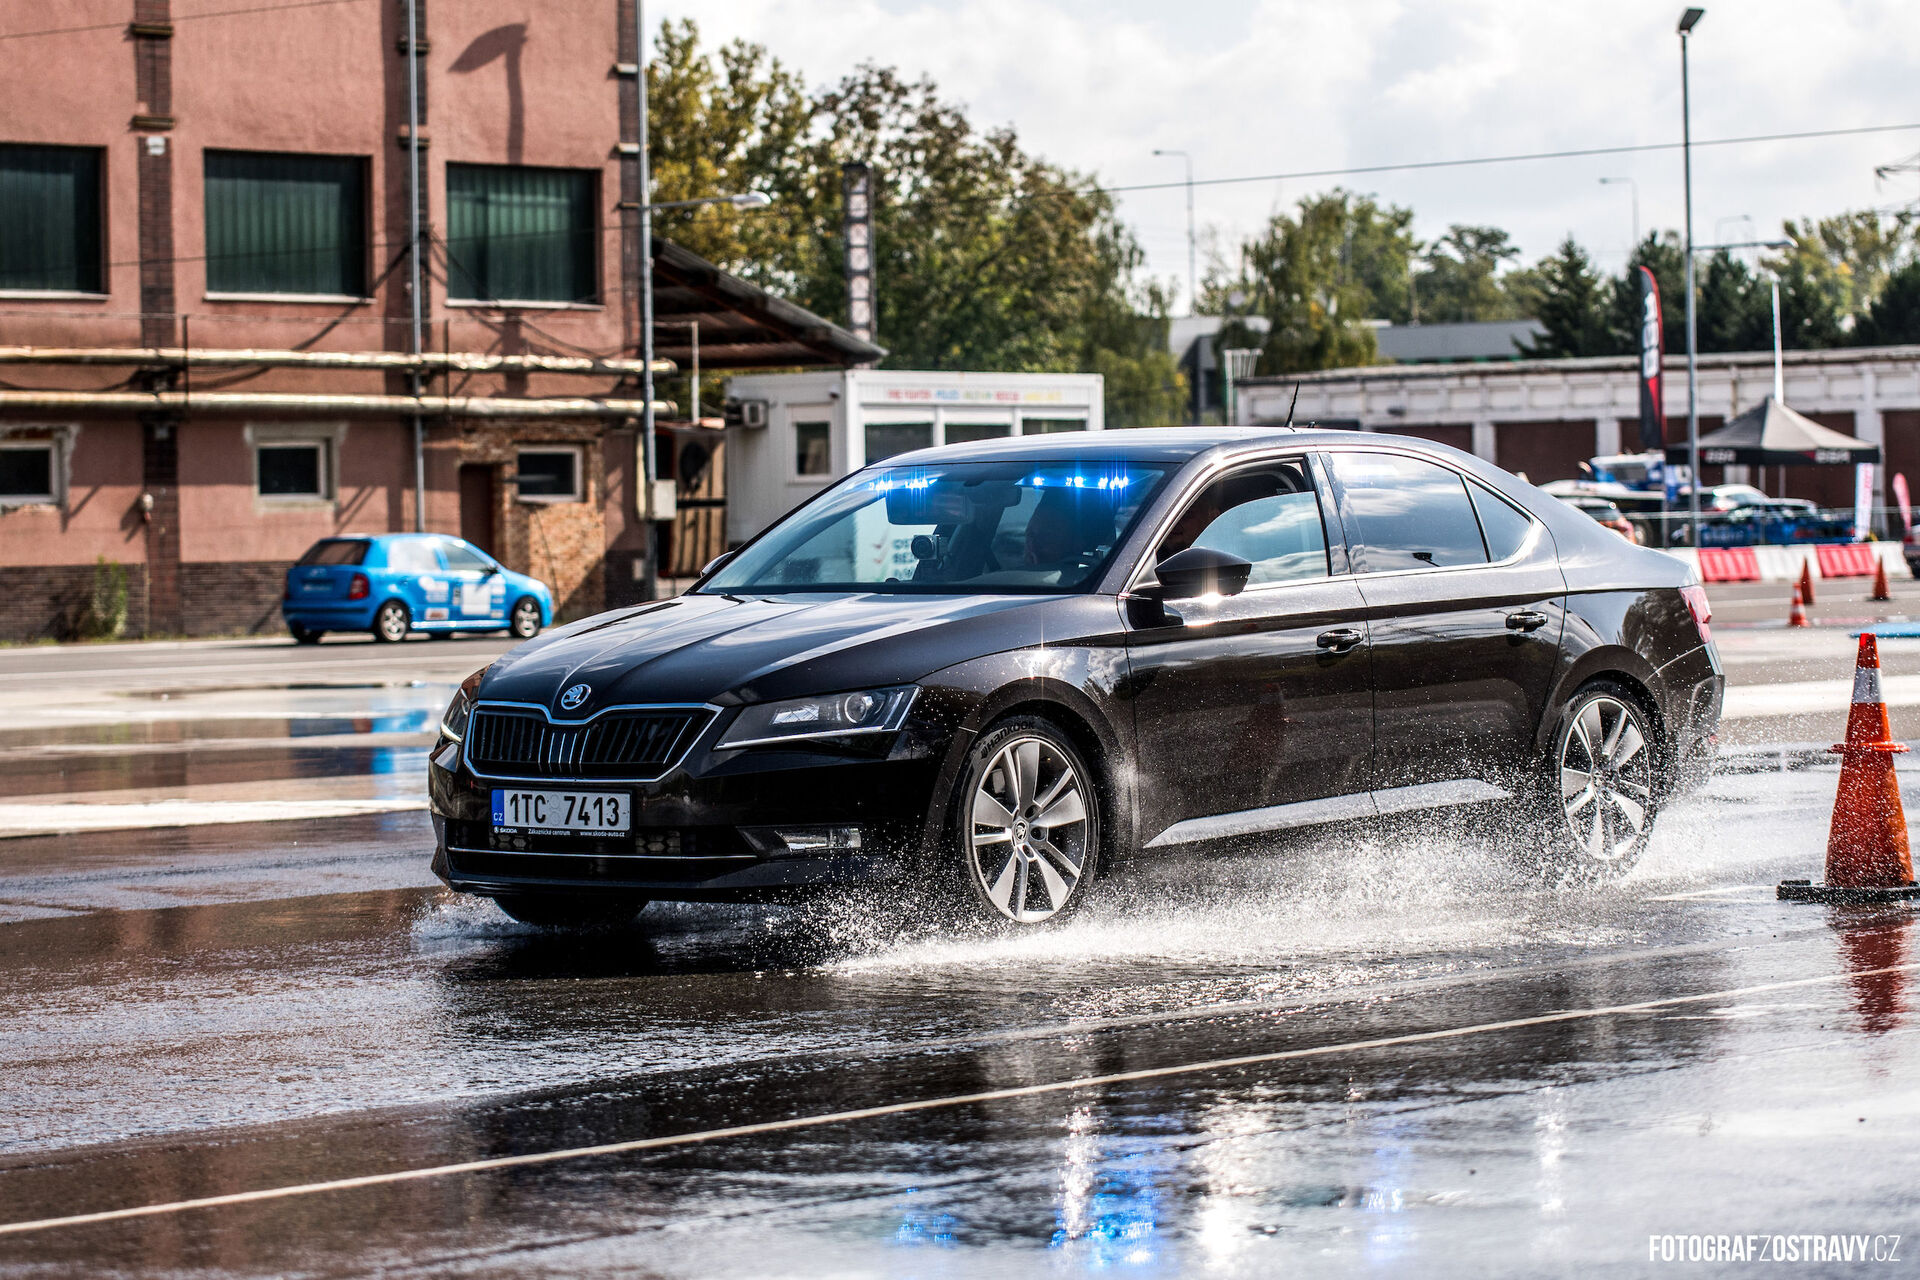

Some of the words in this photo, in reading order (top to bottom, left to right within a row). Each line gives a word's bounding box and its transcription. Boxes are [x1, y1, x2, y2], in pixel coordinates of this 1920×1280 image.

[493, 812, 503, 821] CZ
[509, 793, 546, 824] 1TC
[563, 795, 619, 827] 7413
